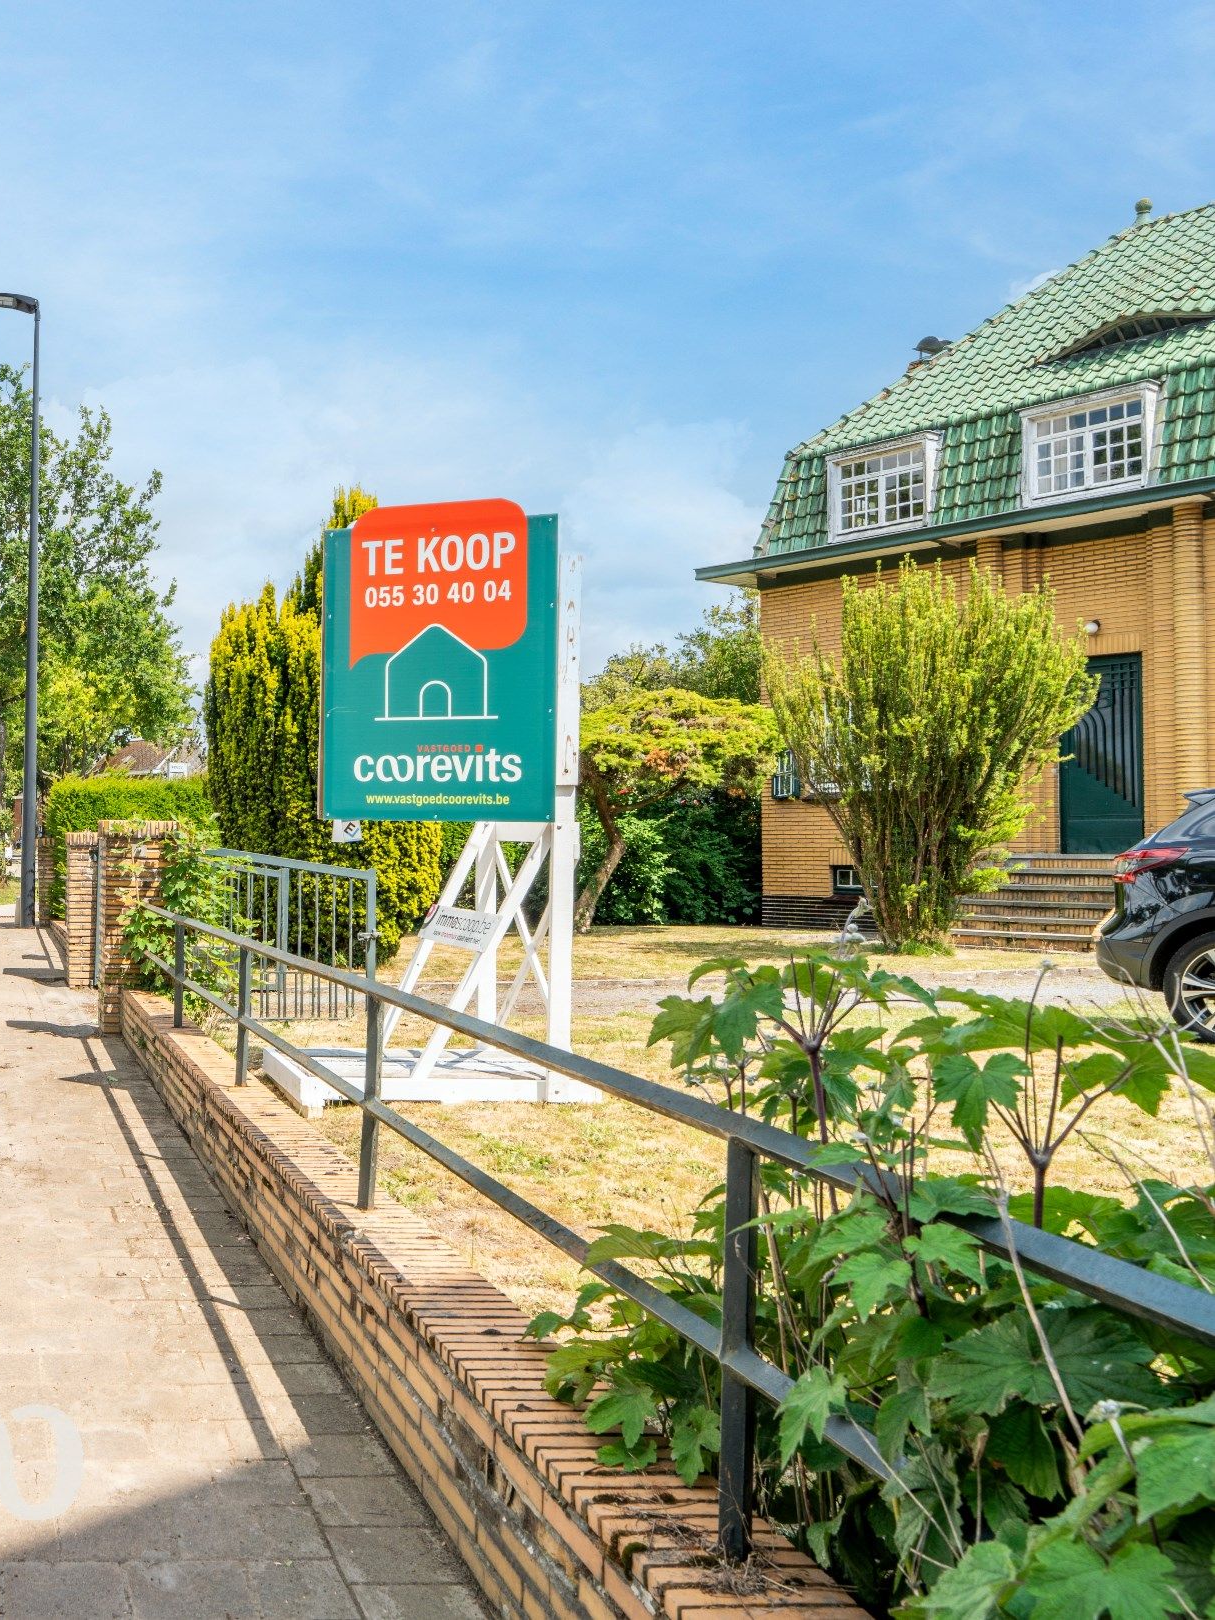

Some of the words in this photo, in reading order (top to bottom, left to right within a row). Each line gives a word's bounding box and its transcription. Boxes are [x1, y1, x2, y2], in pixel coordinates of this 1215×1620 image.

[362, 539, 404, 576] TE
[417, 532, 516, 574] KOOP
[365, 586, 405, 608] 055
[412, 584, 439, 605] 30
[446, 582, 475, 603] 40
[483, 580, 511, 601] 04
[417, 744, 471, 753] VASTGOED
[353, 748, 522, 782] coorevits
[366, 793, 510, 806] www.vastgoedcoorevits.be
